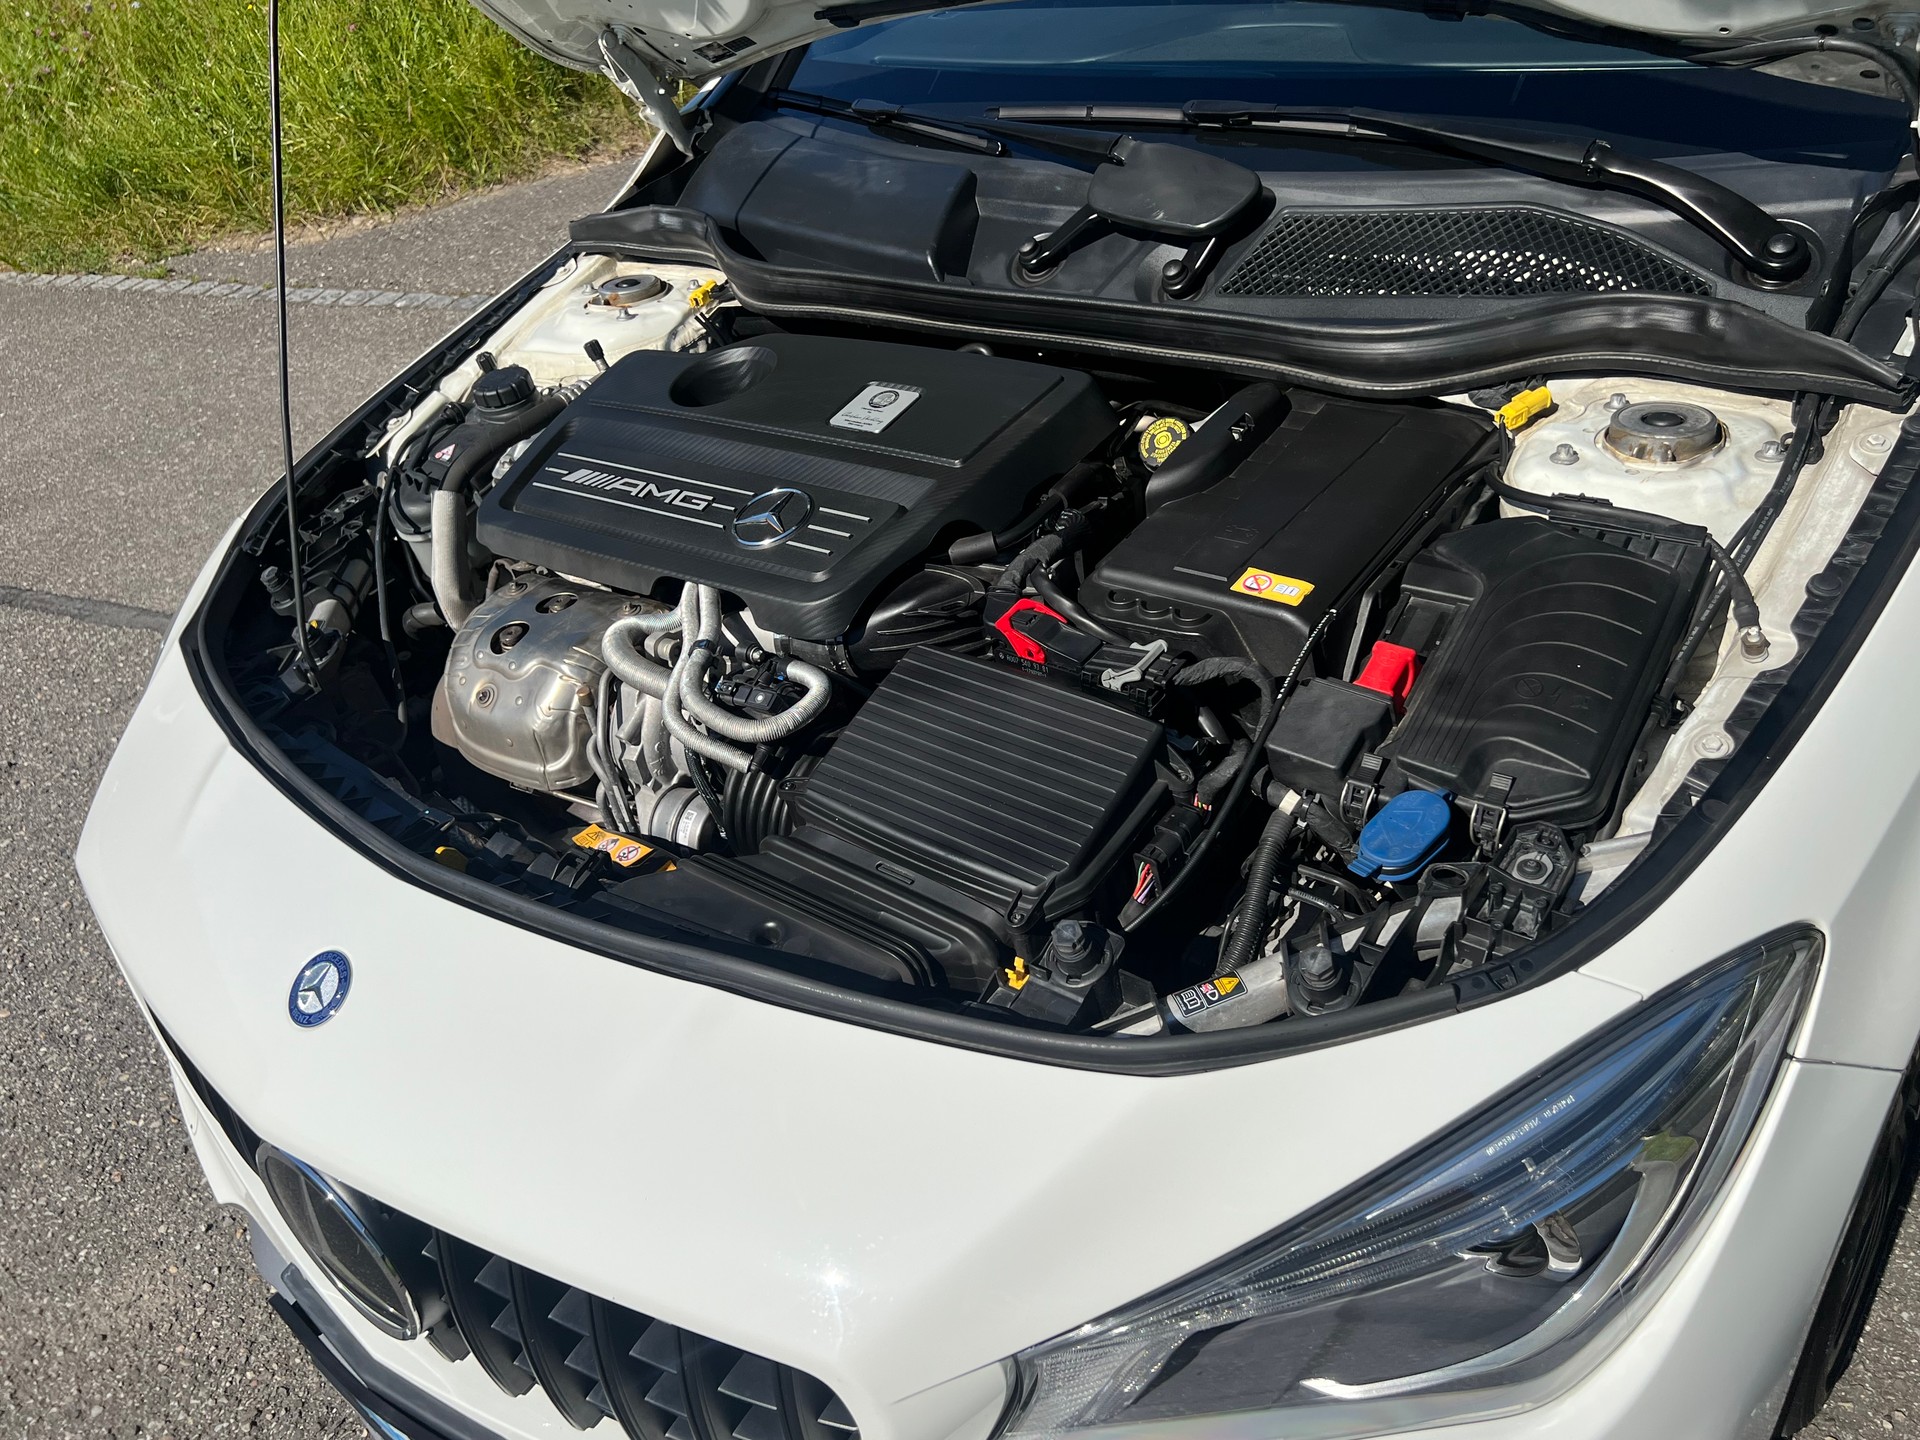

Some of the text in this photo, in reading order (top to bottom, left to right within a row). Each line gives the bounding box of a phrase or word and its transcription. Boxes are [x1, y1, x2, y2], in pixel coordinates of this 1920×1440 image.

[604, 477, 714, 511] AMG
[316, 952, 347, 979] MERCEDES
[291, 1007, 310, 1024] BENZ
